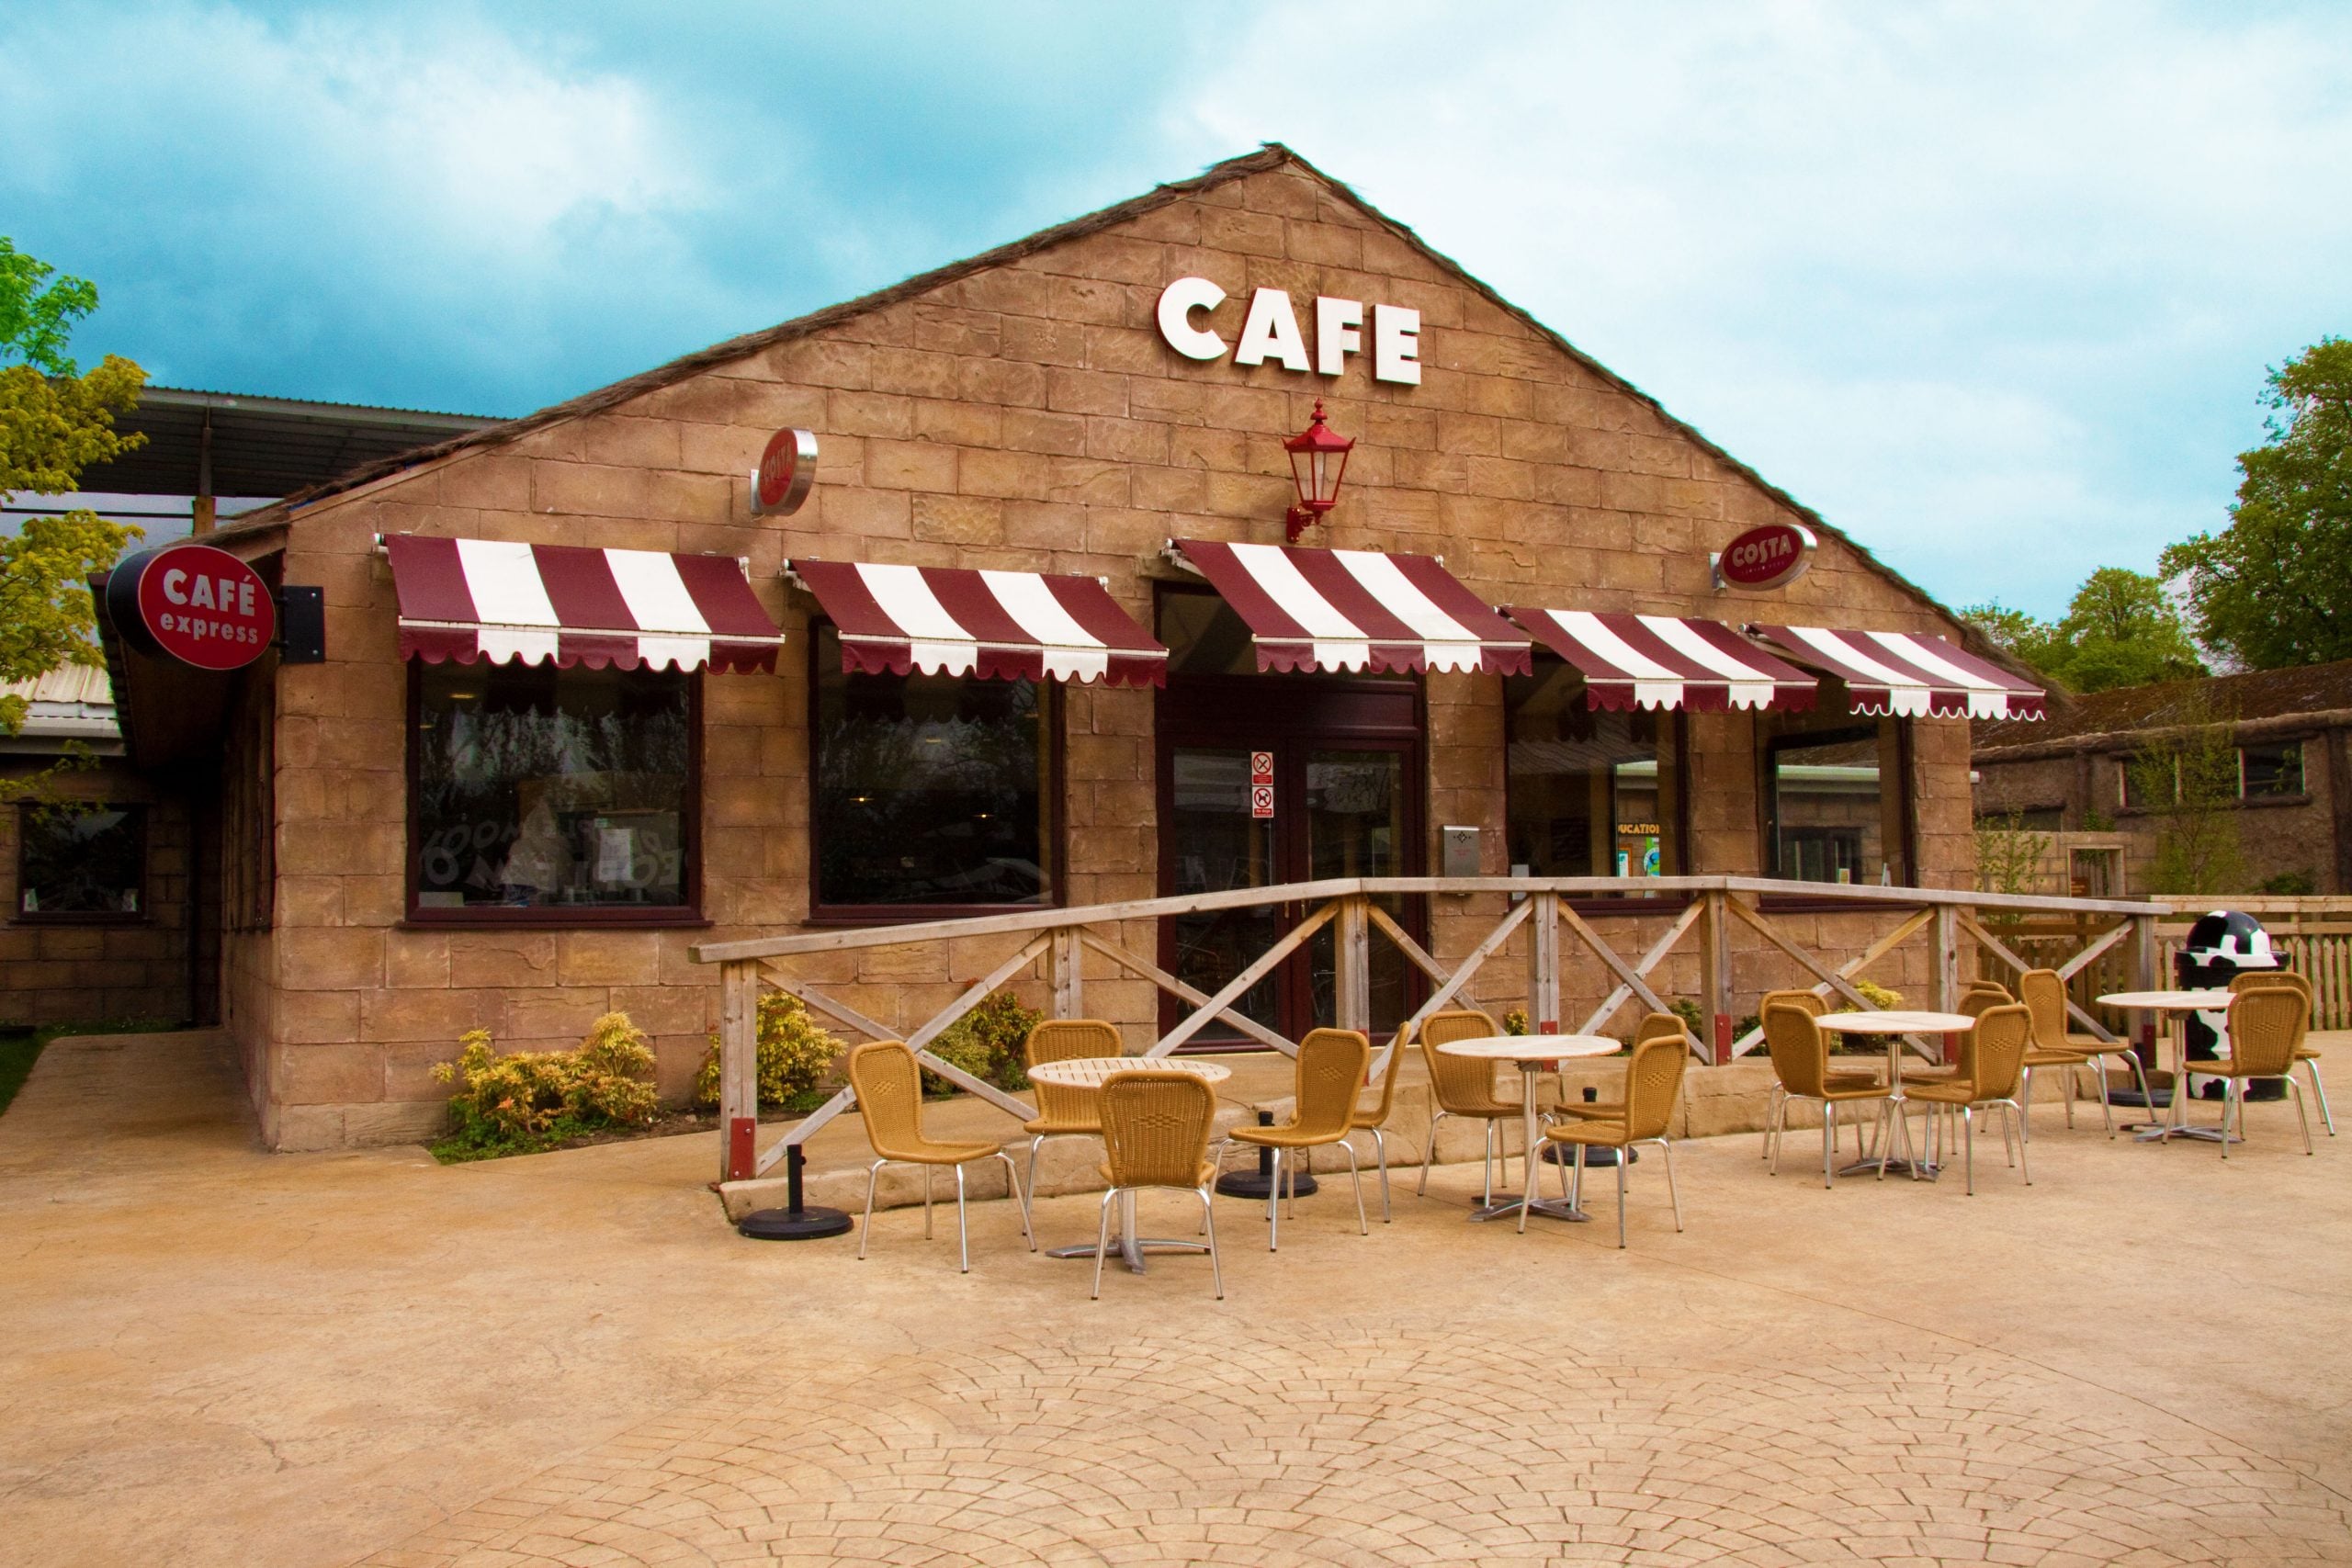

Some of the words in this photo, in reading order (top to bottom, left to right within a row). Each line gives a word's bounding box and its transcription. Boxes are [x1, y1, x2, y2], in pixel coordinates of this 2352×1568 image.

[1156, 276, 1421, 386] CAFE
[1732, 534, 1792, 567] COSTA
[164, 569, 255, 616] CAFÉ
[161, 613, 258, 644] express
